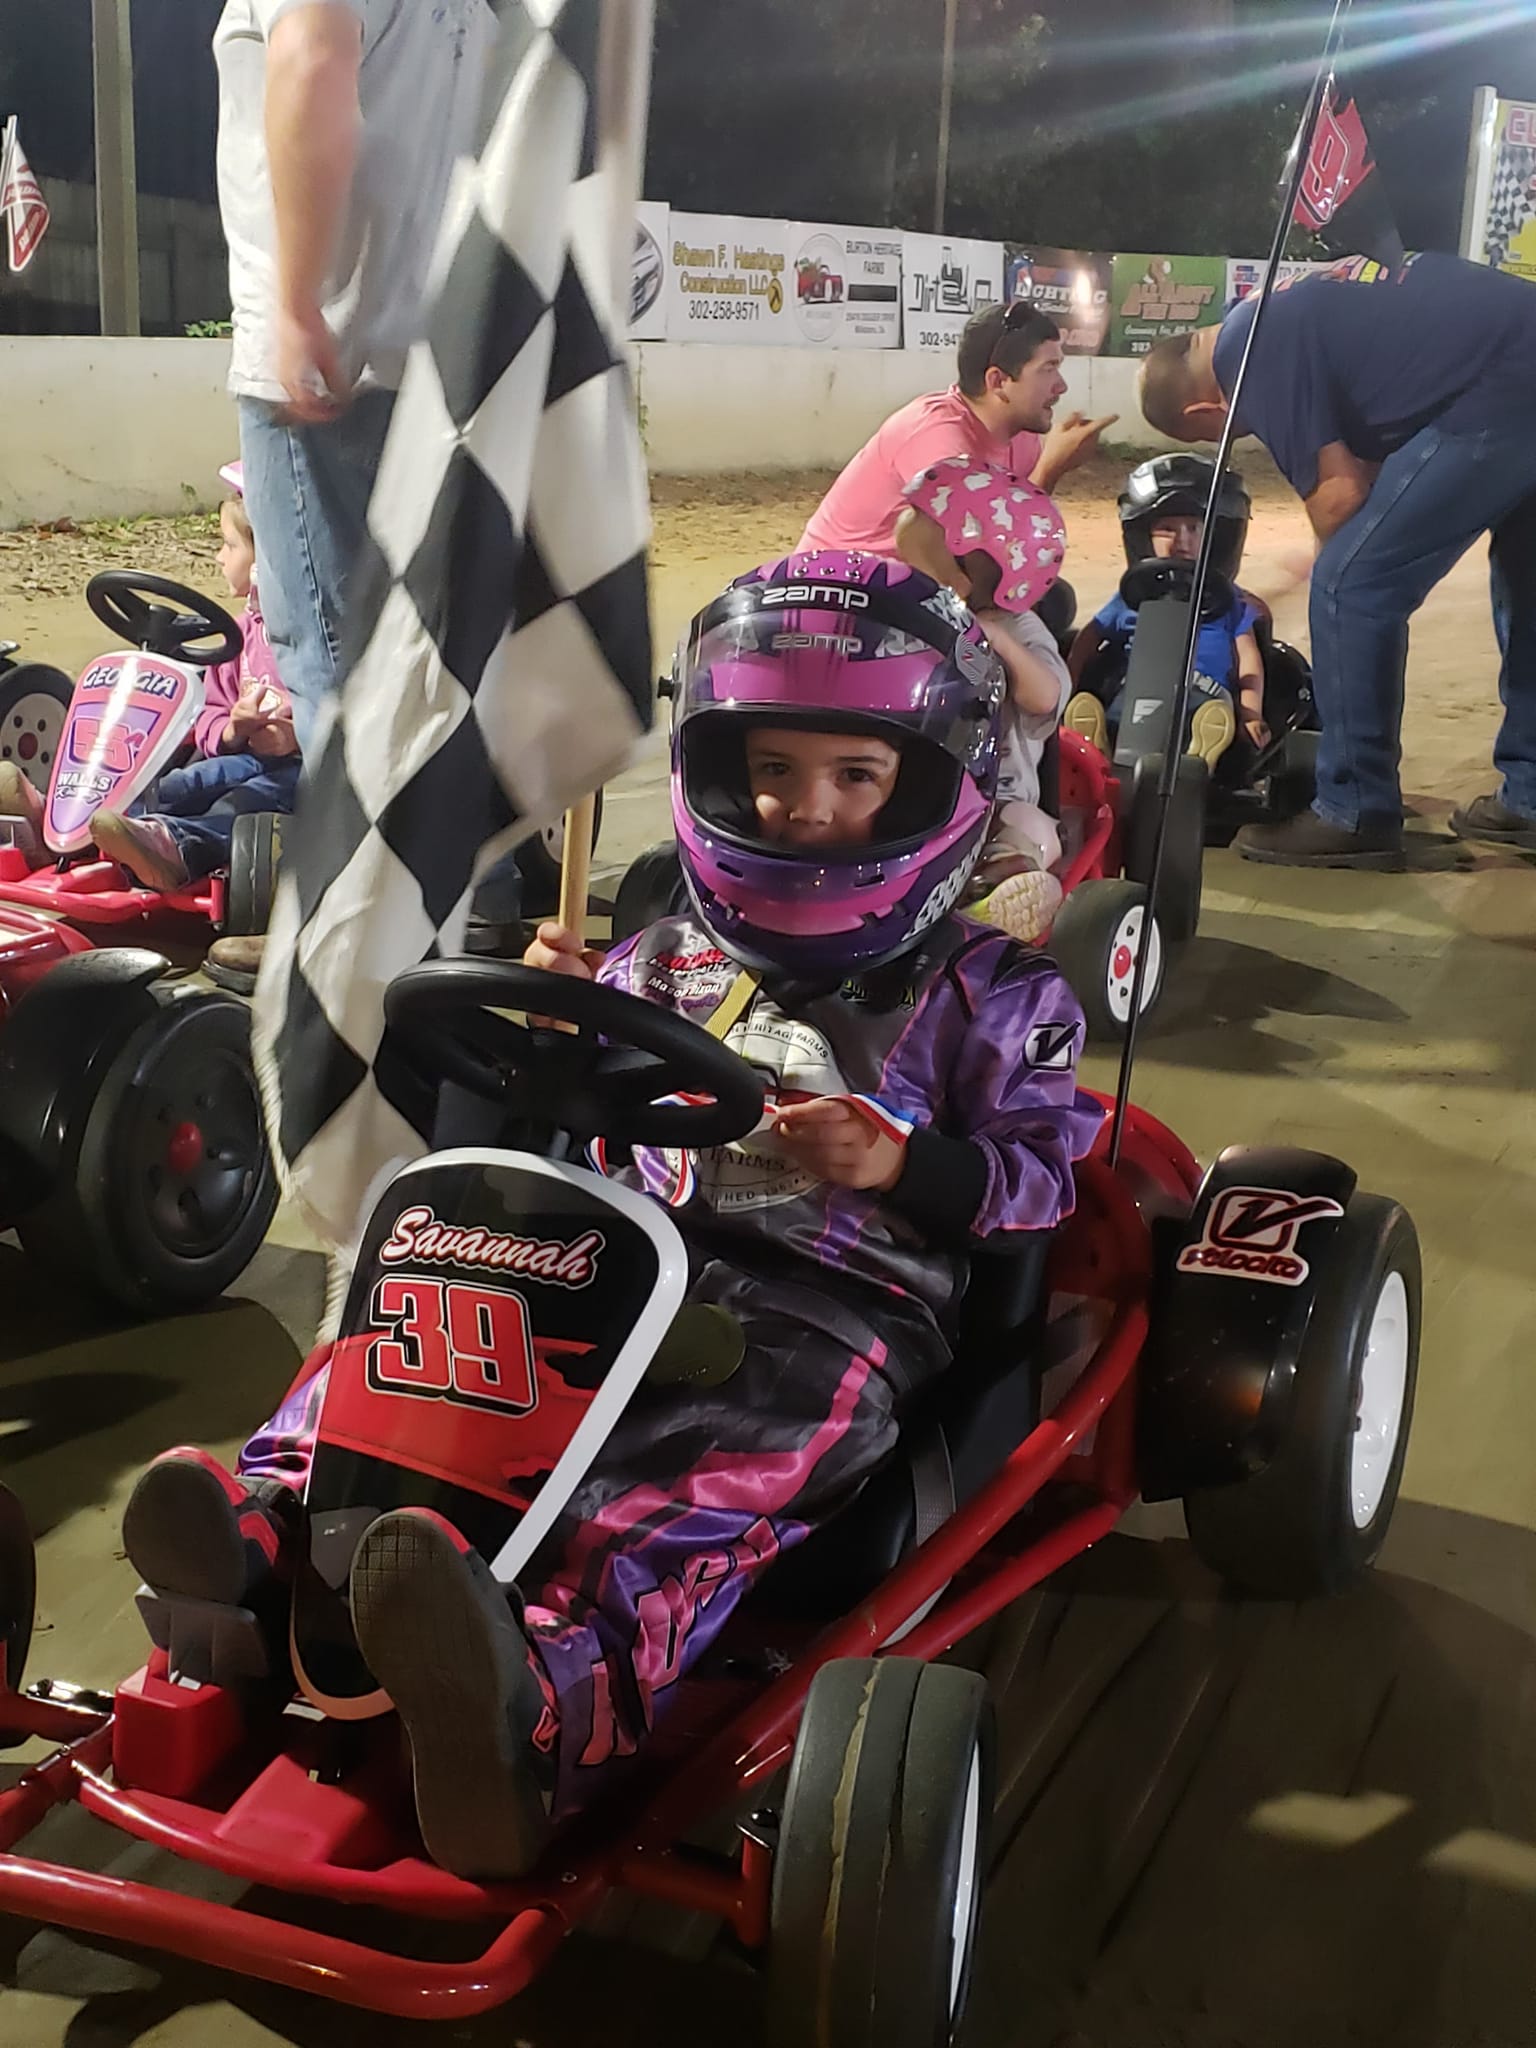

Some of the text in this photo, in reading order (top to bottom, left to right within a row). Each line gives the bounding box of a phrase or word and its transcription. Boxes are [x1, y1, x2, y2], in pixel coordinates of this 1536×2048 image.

[680, 271, 769, 295] Construction LLC
[761, 585, 870, 609] zamp
[771, 633, 864, 656] zamp
[83, 667, 178, 699] GEOGIA
[379, 1205, 607, 1291] Savannah
[365, 1272, 540, 1420] 39
